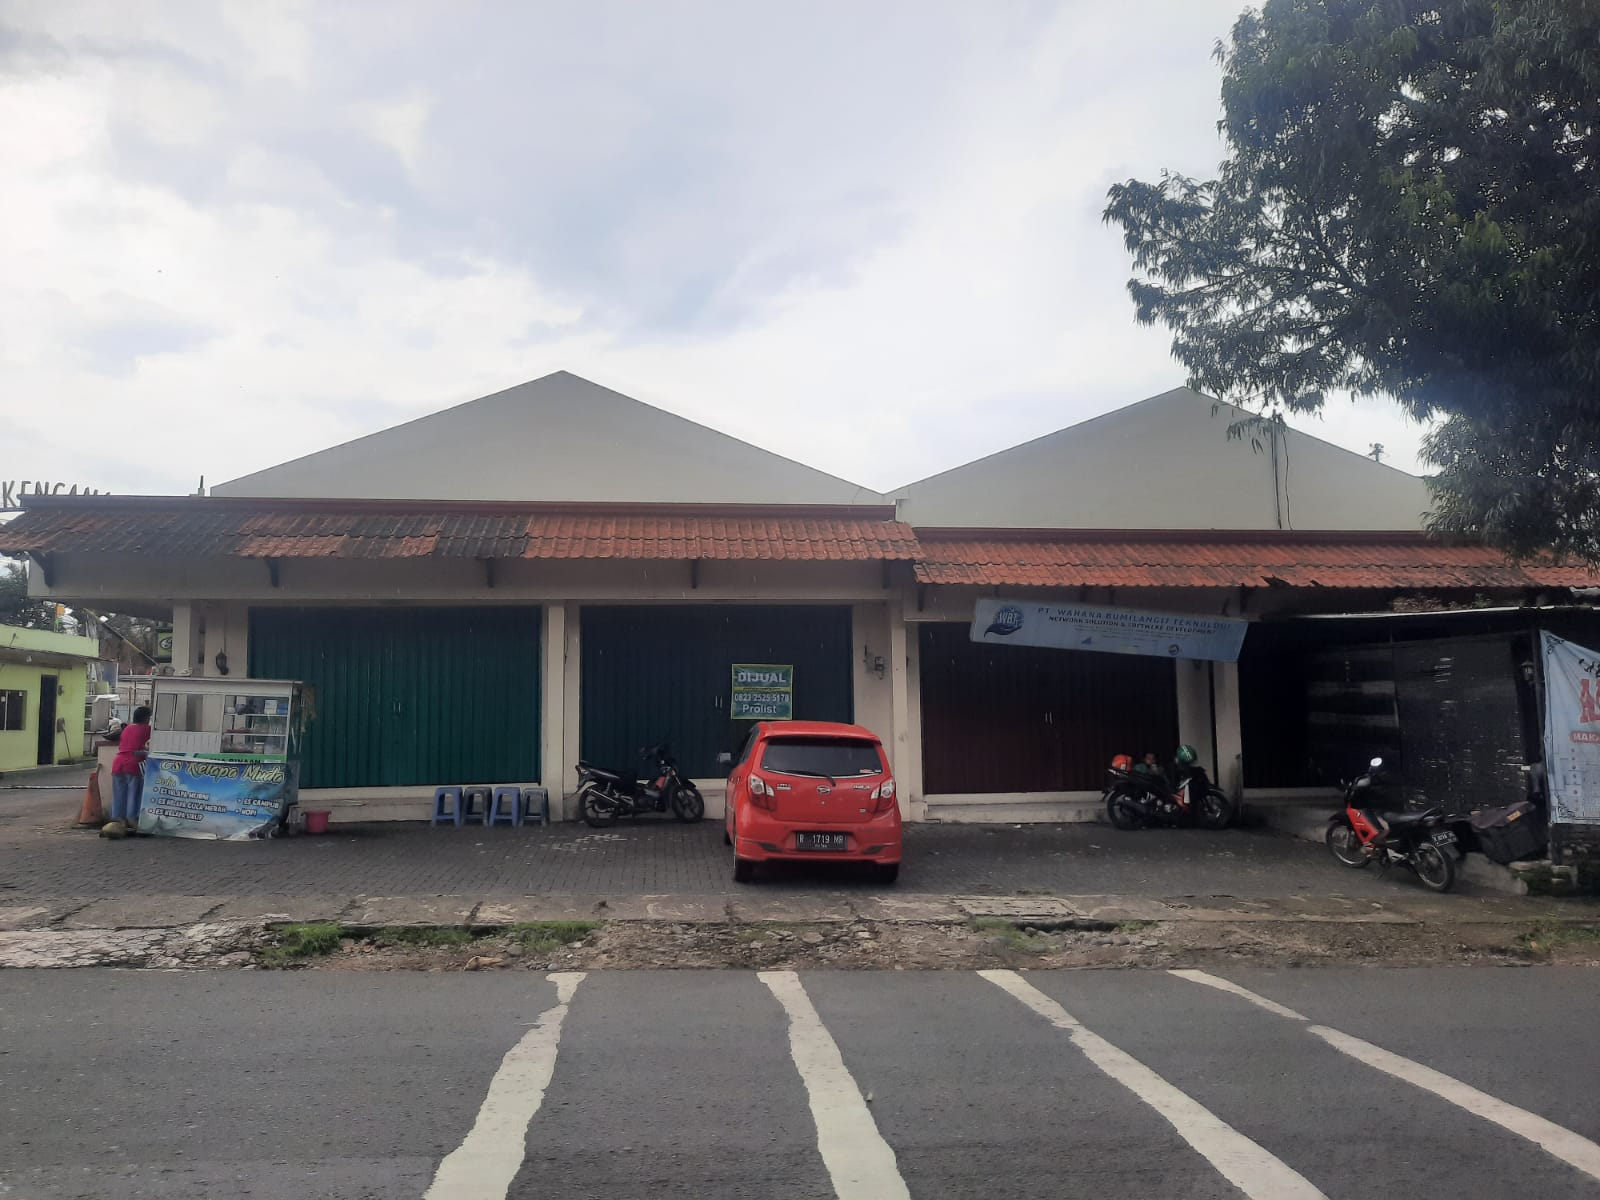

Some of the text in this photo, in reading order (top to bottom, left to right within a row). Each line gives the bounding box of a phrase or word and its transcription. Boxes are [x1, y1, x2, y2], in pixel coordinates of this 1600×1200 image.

[1057, 608, 1102, 618] WAHANA
[1049, 615, 1083, 624] NETWORK
[1085, 618, 1118, 627] SOLUTION
[737, 672, 787, 683] DIJUAL
[742, 704, 777, 714] Prolist
[243, 764, 285, 784] Muda
